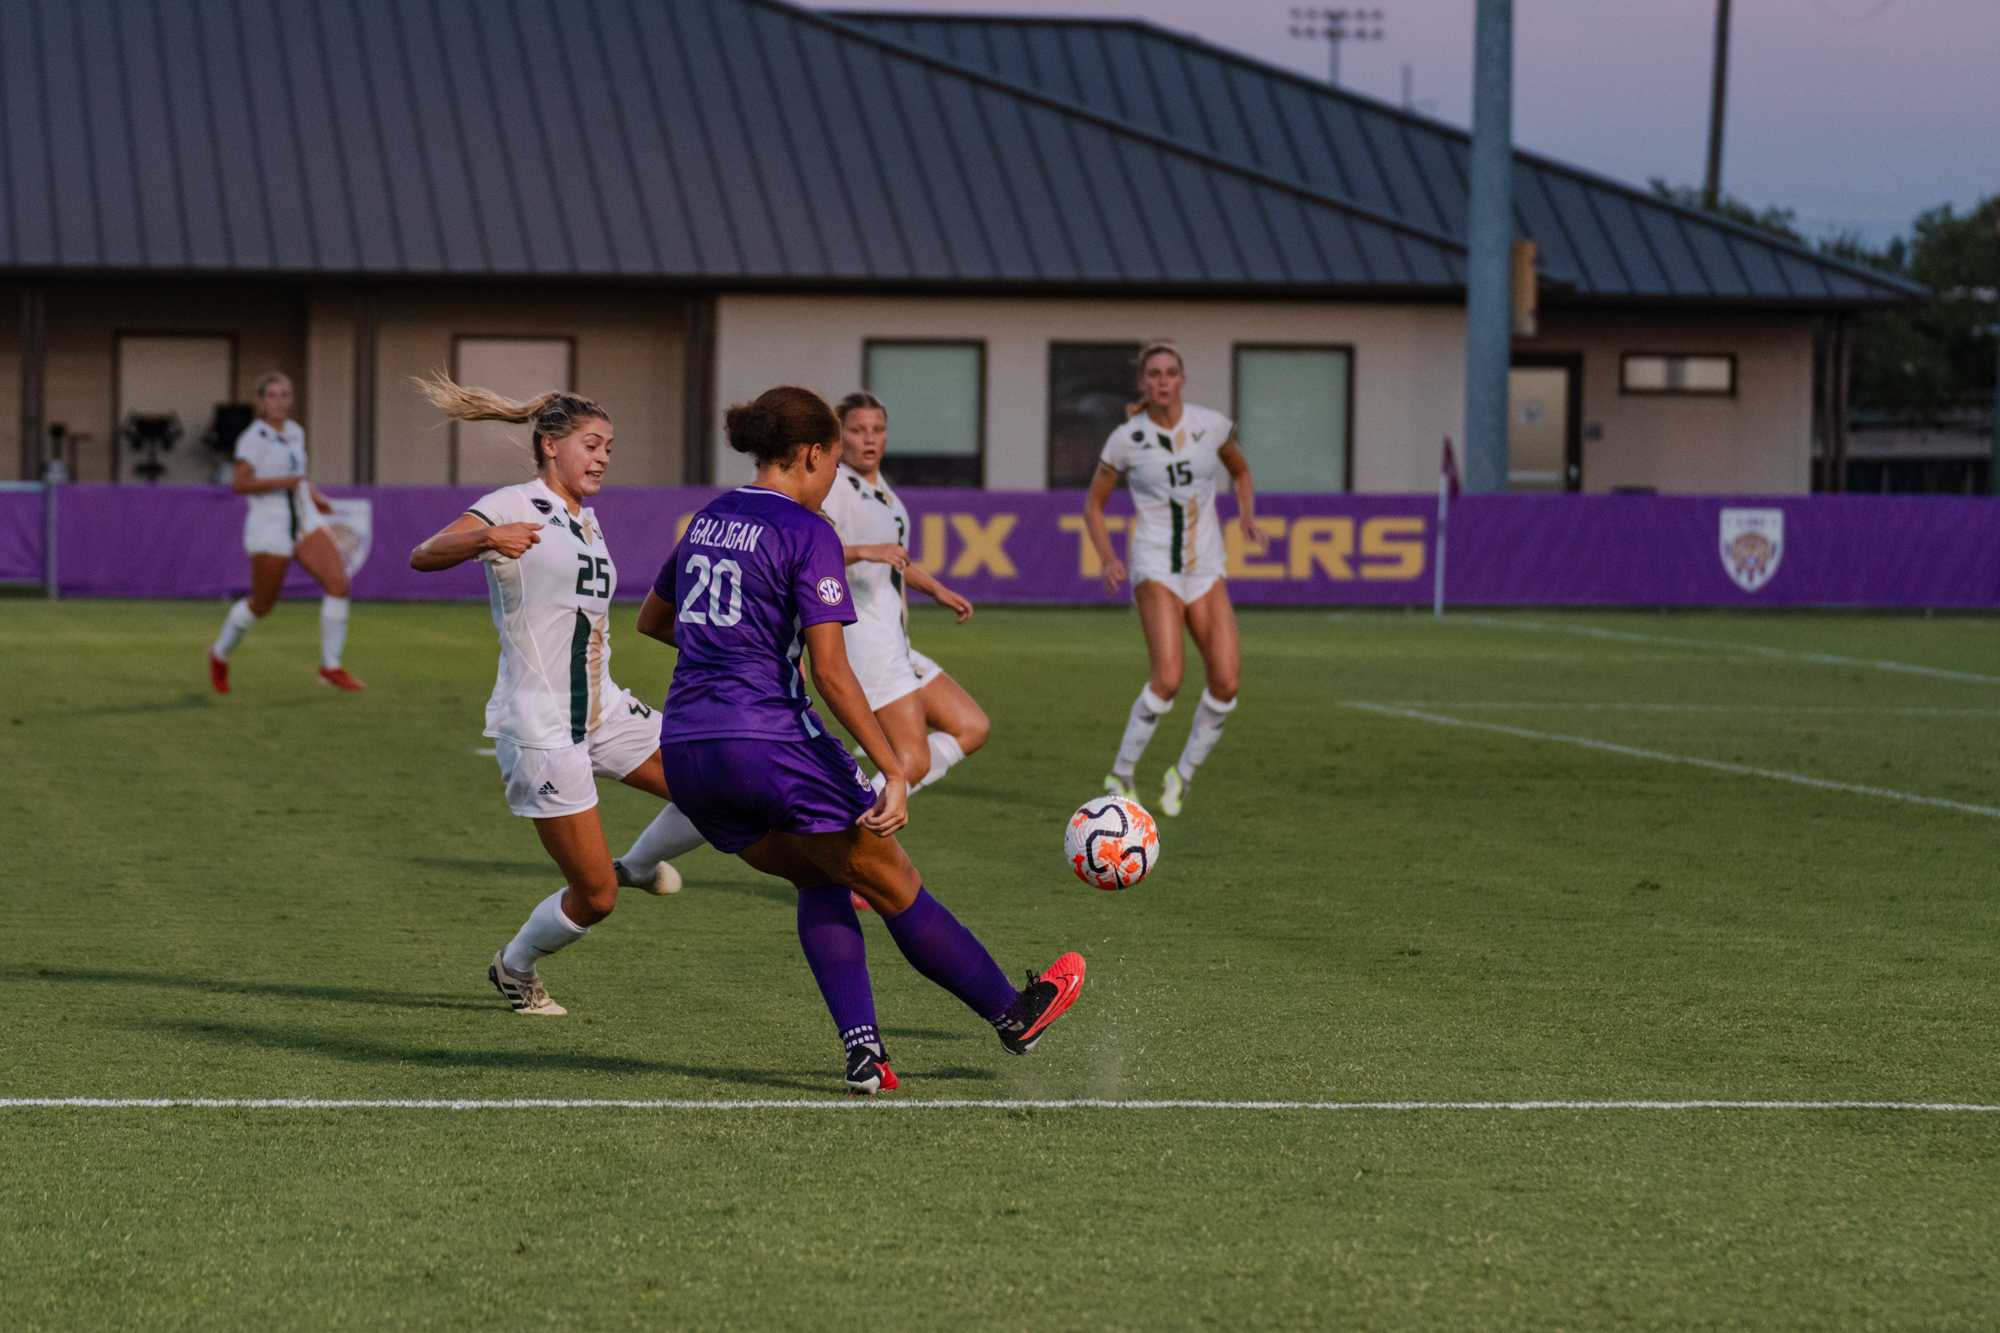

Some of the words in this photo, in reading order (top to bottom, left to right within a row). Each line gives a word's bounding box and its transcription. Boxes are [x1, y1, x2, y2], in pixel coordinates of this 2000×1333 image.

[1167, 461, 1193, 488] 15
[690, 518, 764, 553] GALLIGAN
[576, 553, 610, 599] 25
[679, 554, 742, 627] 20
[819, 579, 841, 603] SEC
